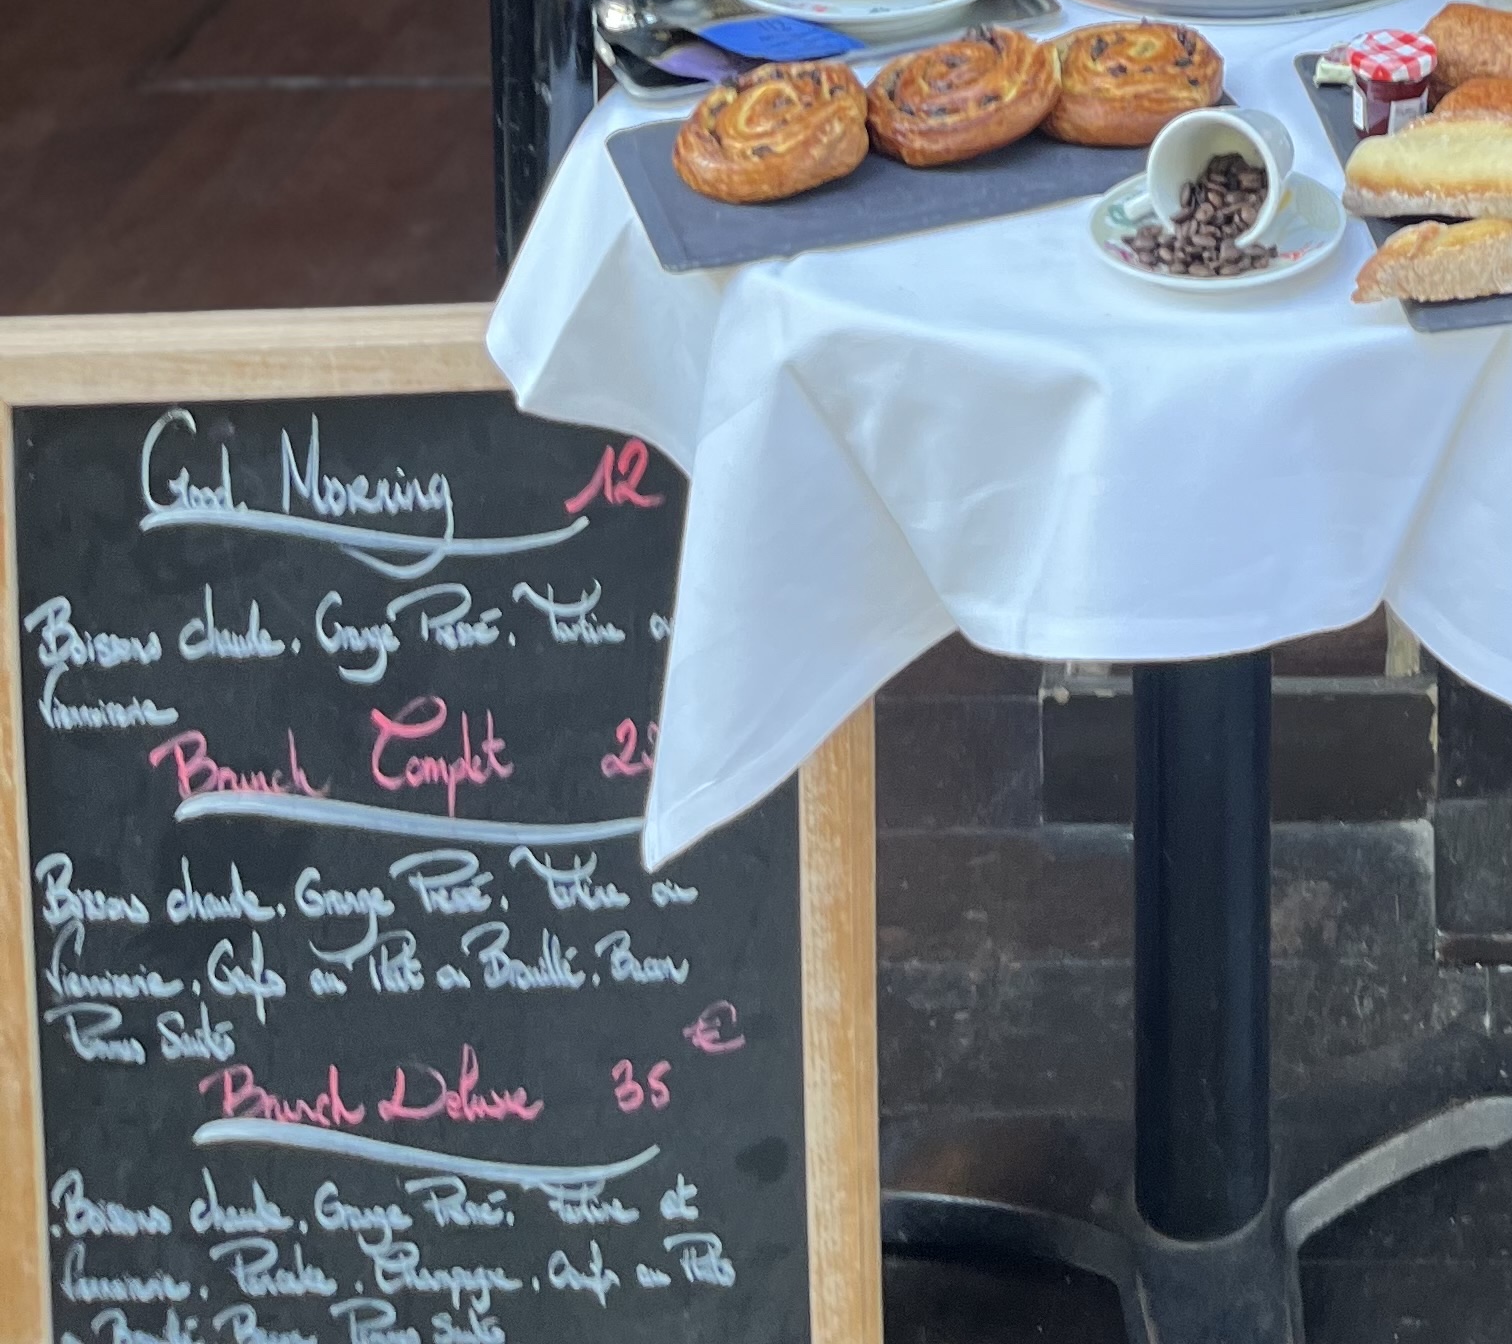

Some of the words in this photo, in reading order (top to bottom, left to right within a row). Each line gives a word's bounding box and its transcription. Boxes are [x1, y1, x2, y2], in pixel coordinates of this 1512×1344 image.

[141, 408, 249, 512] Good
[281, 411, 455, 579] Morning
[564, 438, 667, 513] 12
[149, 729, 332, 800] Brunch
[370, 694, 514, 818] Complet
[199, 1062, 366, 1127] Brunch
[611, 1058, 673, 1114] 35
